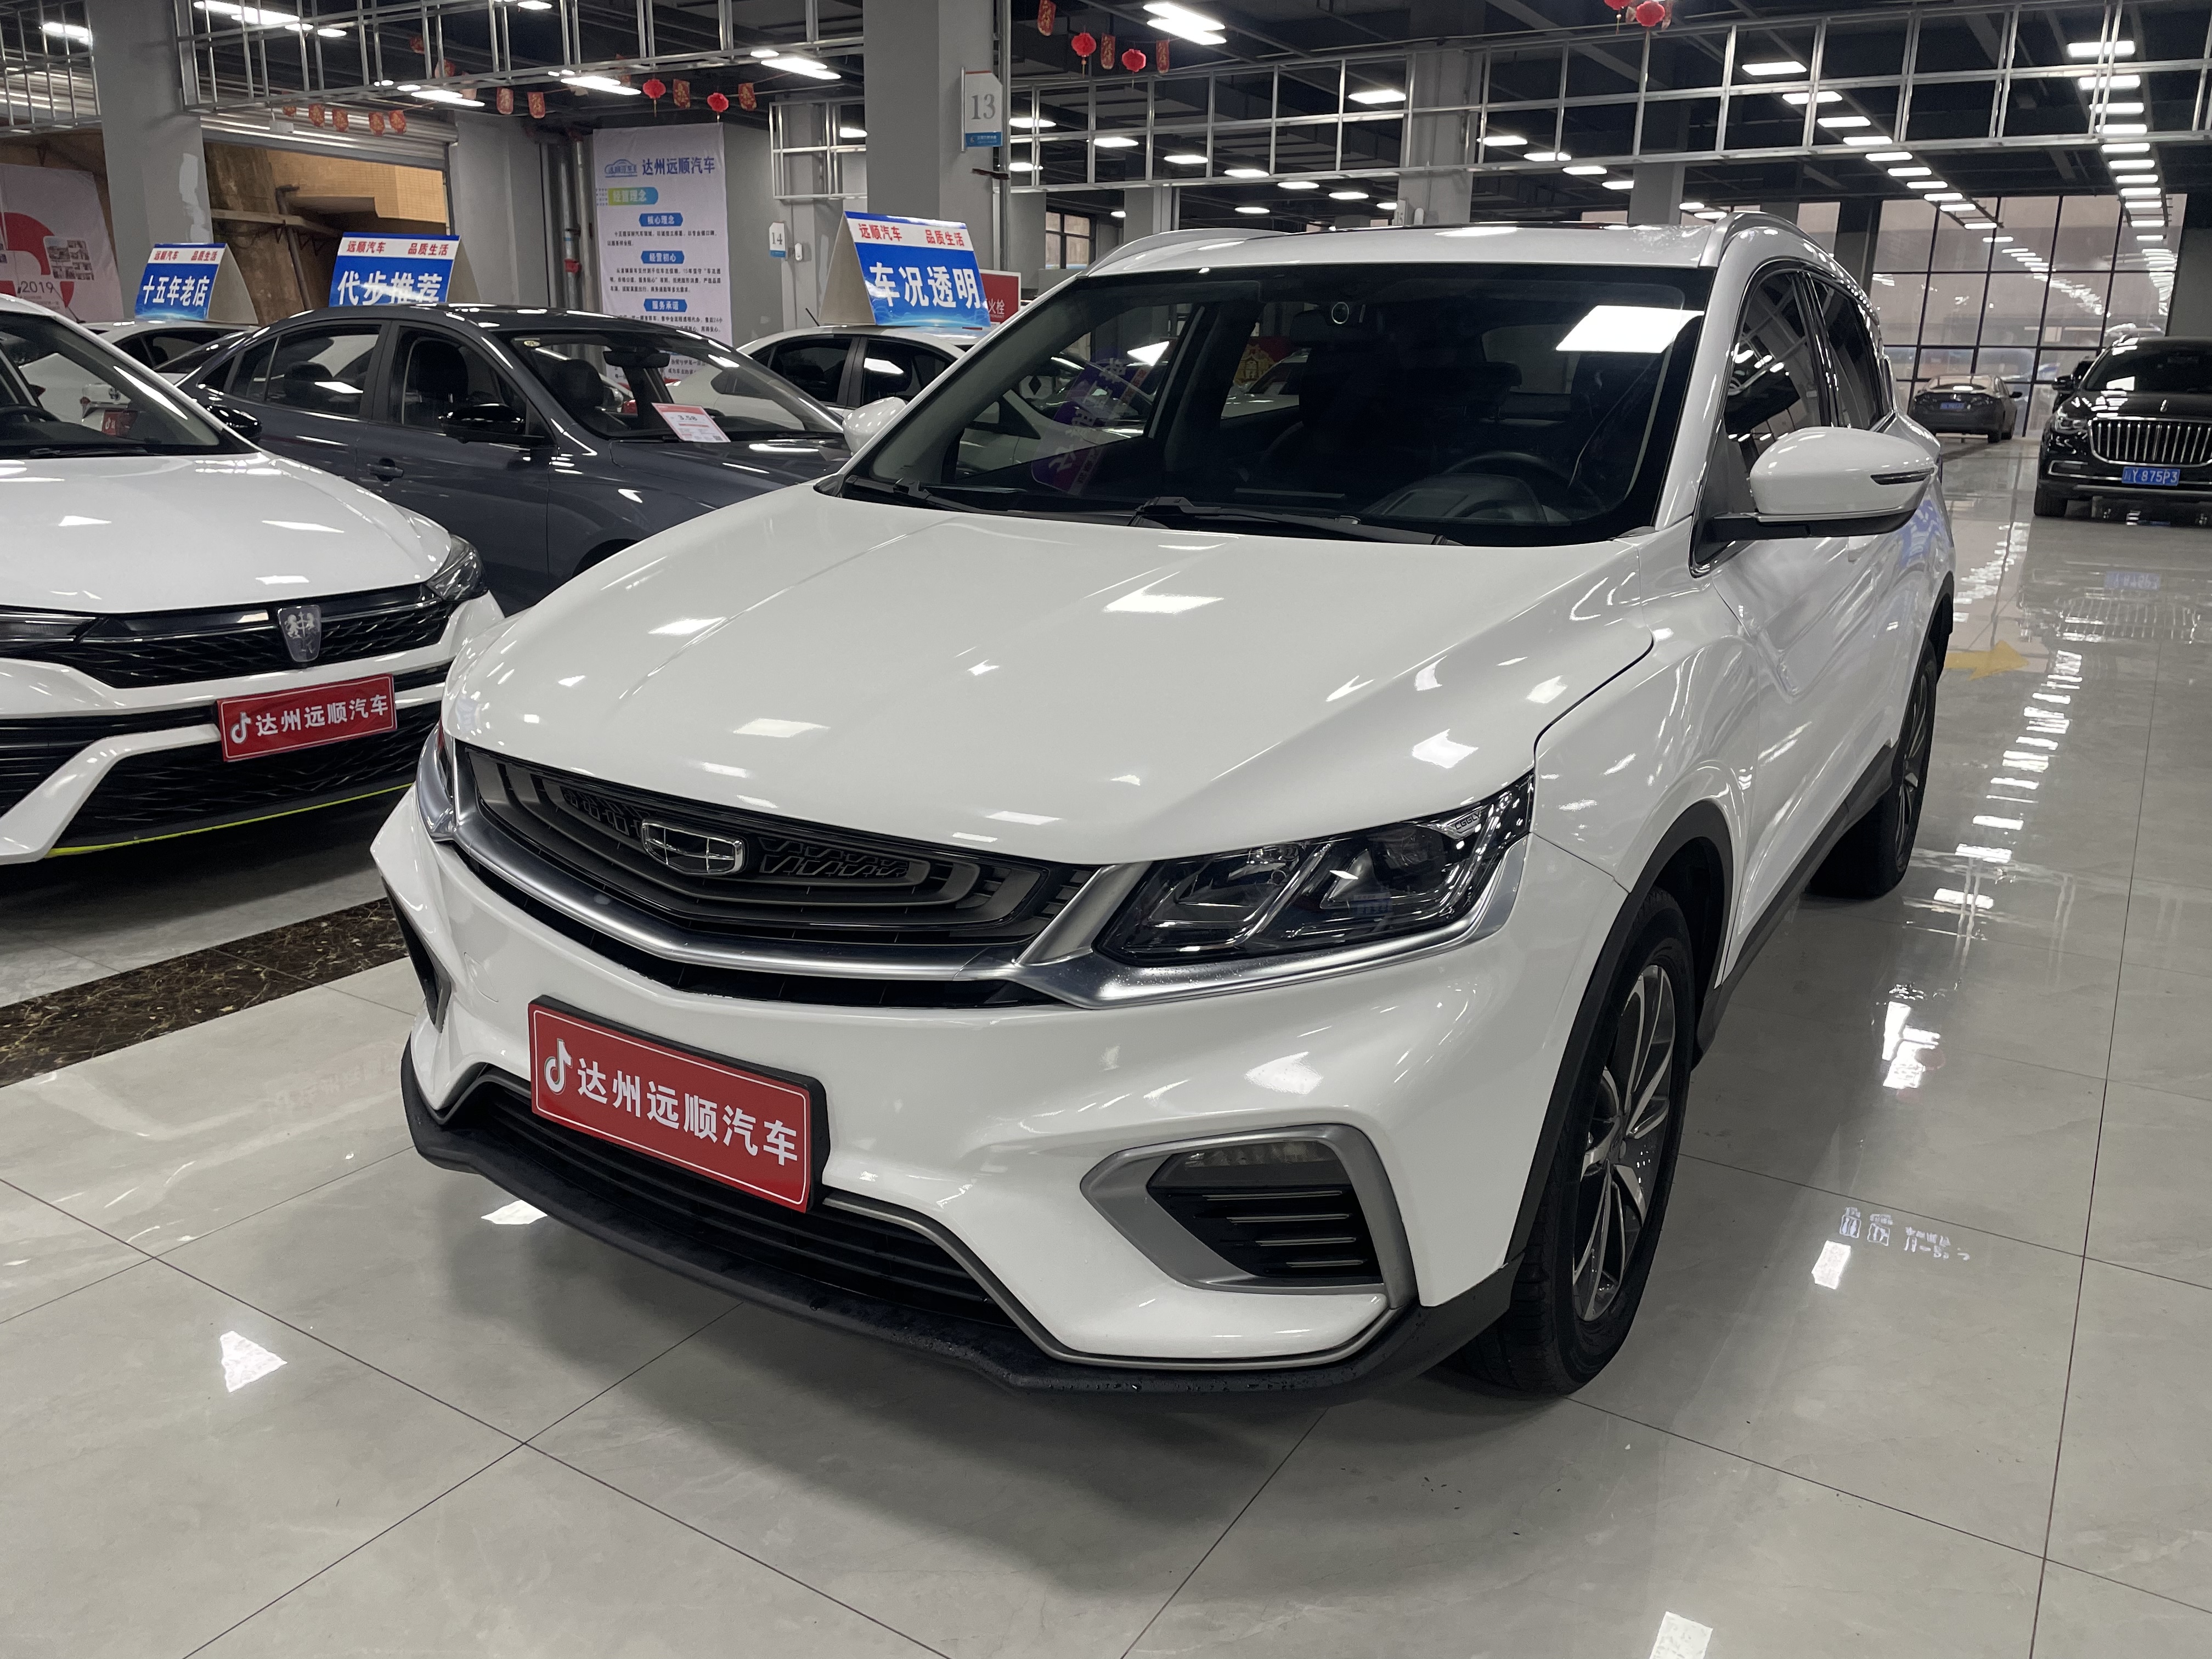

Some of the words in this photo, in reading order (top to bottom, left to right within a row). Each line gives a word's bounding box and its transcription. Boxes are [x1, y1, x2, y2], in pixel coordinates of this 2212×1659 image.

[971, 94, 996, 120] 13
[642, 156, 715, 176] 达州远顺汽车
[772, 233, 782, 245] 14
[858, 223, 902, 241] 远顺汽车
[925, 229, 964, 246] 品质生活
[154, 251, 179, 261] 远顺汽车
[190, 251, 218, 261] 品质生活
[346, 241, 386, 253] 远顺汽车
[408, 243, 449, 256] 品质生活
[20, 280, 54, 294] 2019
[143, 275, 210, 307] 十五年老店
[337, 270, 442, 305] 代步推荐
[870, 262, 981, 309] 车况透明
[986, 298, 1005, 314] 火栓
[256, 695, 388, 737] 达州远顺汽车
[577, 1058, 798, 1166] 达州远顺汽车
